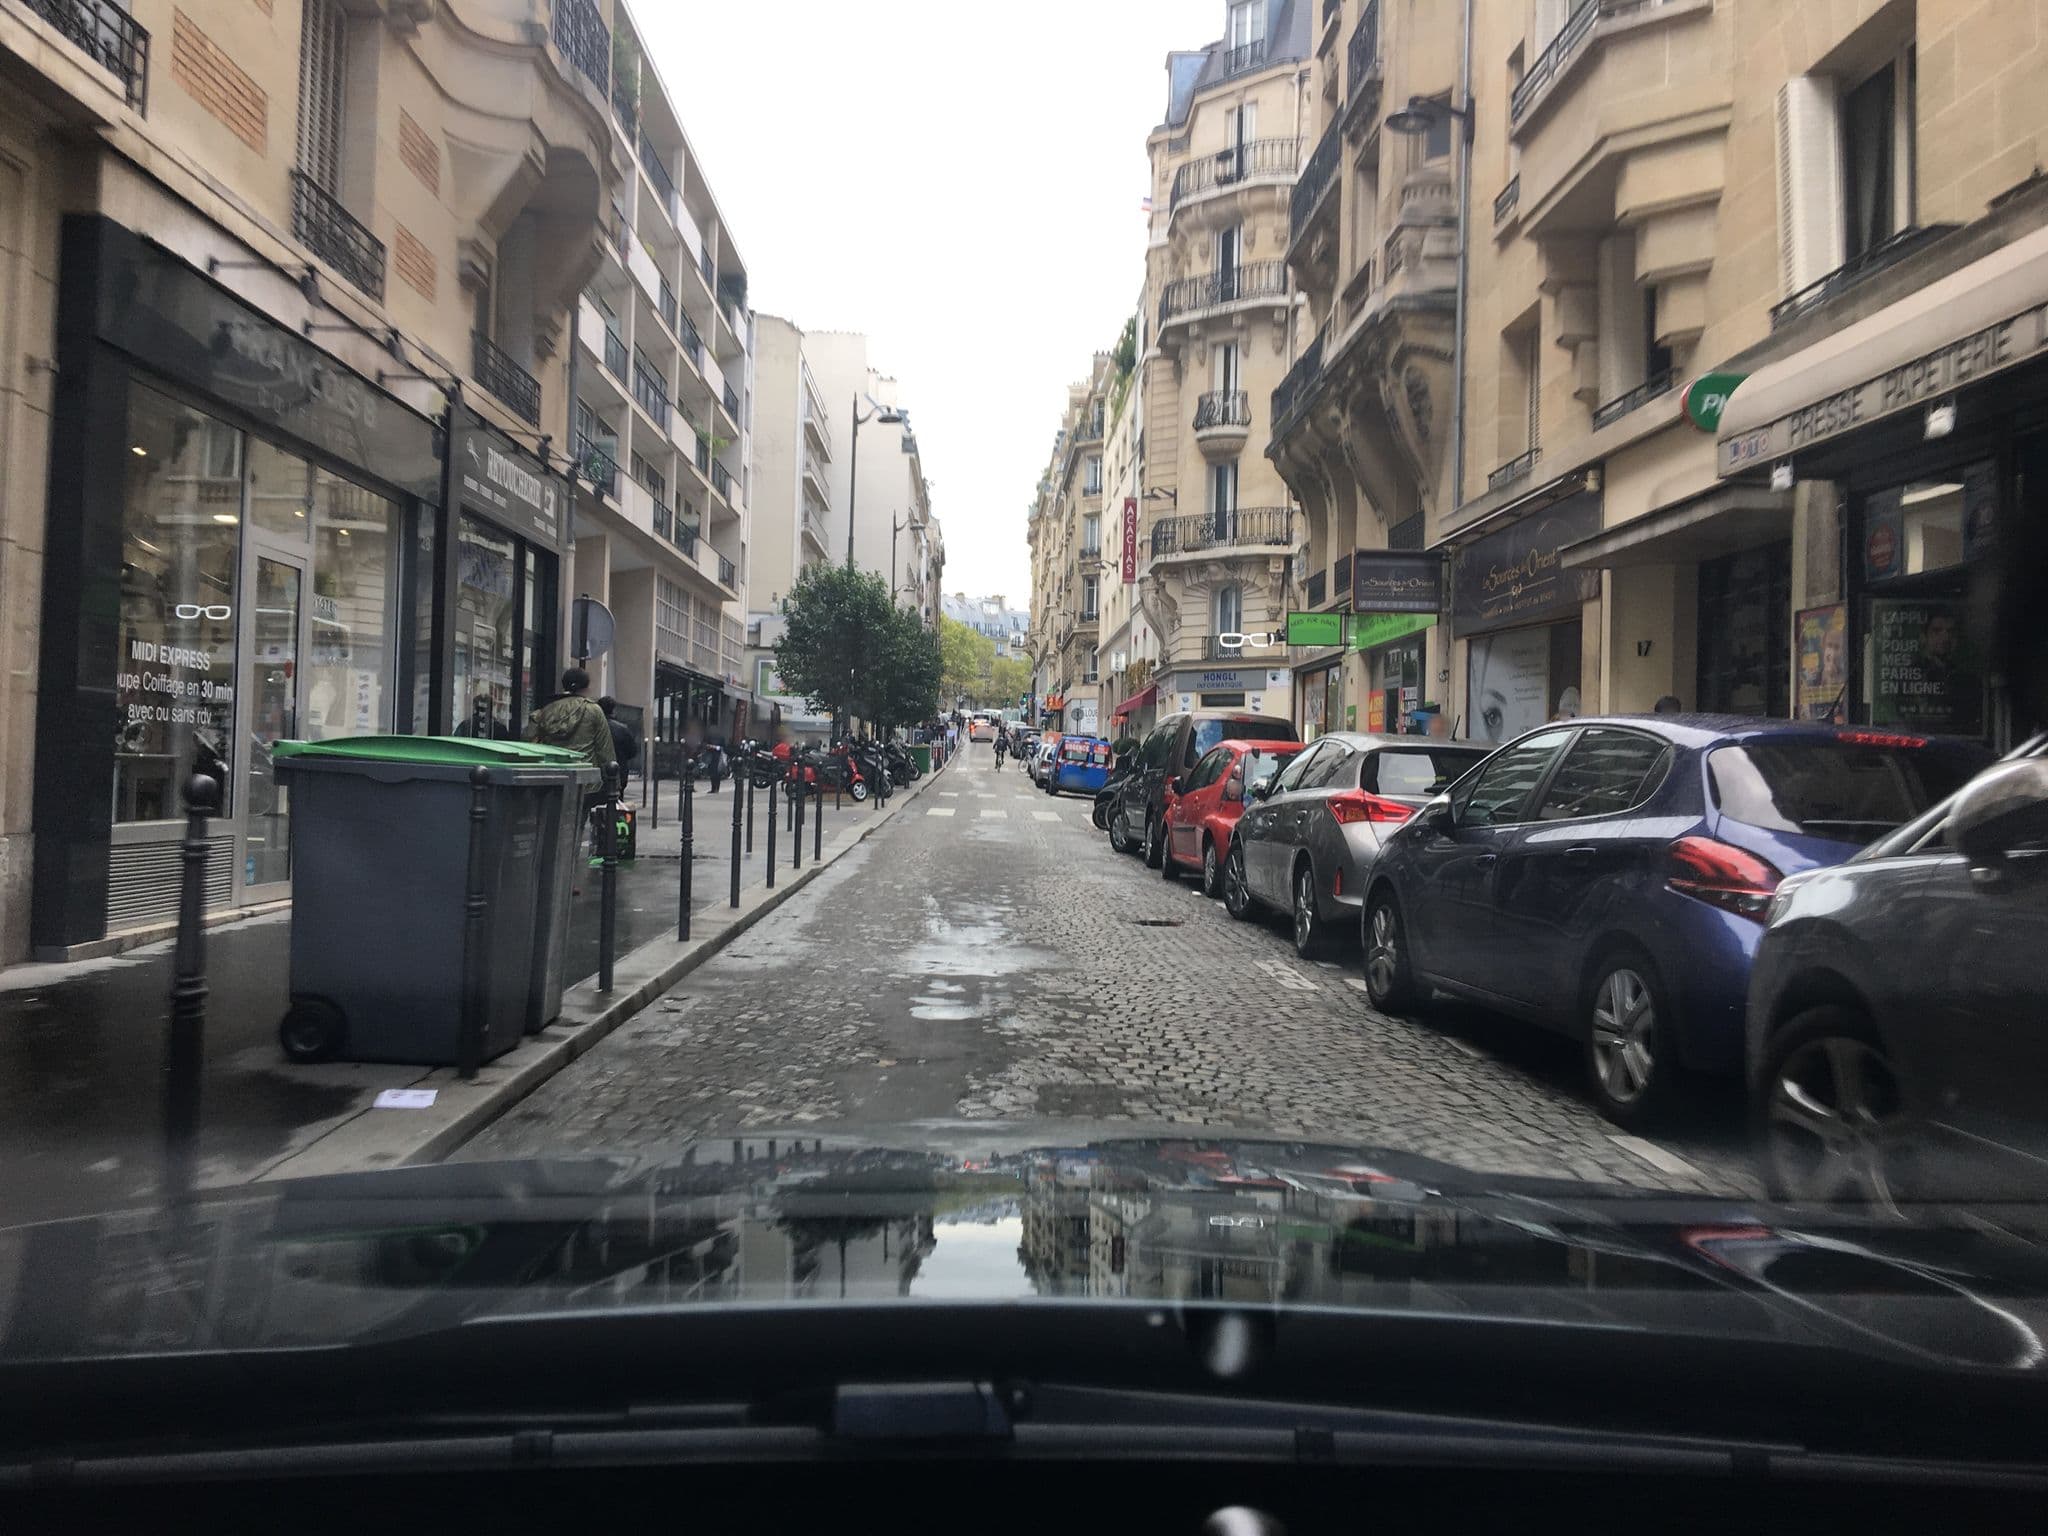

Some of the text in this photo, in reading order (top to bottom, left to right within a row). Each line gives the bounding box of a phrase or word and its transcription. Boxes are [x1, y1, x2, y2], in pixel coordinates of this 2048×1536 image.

[1730, 435, 1769, 464] LOTO
[1788, 389, 1865, 446] PRESSE
[1880, 323, 2011, 411] PAPETERIE
[1126, 505, 1135, 574] ACACIAS
[1637, 639, 1652, 656] 17
[1881, 640, 1918, 652] POUR
[131, 640, 210, 671] MIDI EXPRESS
[1881, 653, 1911, 666] MES
[1203, 672, 1237, 681] HONGLI
[1881, 667, 1921, 680] PARIS
[143, 671, 184, 698] Coiffage
[187, 682, 199, 696] en
[201, 680, 213, 698] 30
[215, 682, 233, 700] min
[1196, 681, 1243, 689] INFORMATIQUE
[1881, 681, 1898, 694] EN
[128, 703, 211, 725] avec ou sans rdv
